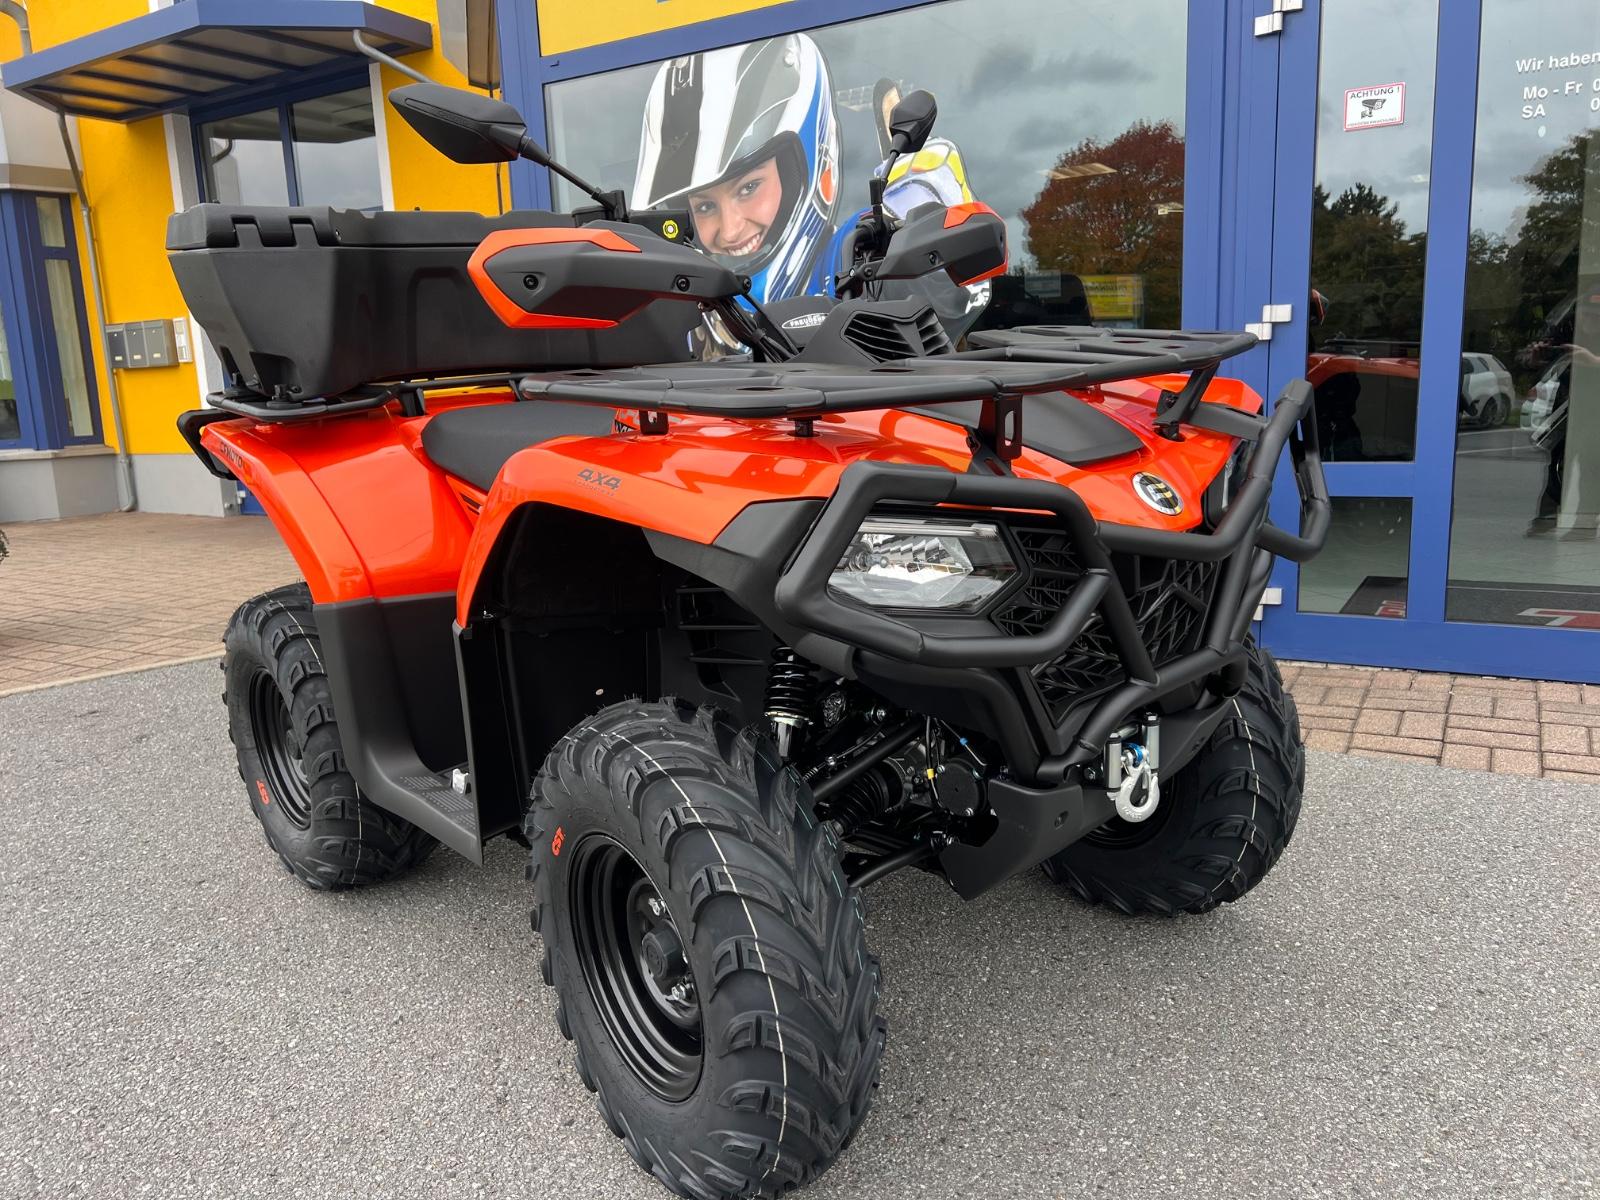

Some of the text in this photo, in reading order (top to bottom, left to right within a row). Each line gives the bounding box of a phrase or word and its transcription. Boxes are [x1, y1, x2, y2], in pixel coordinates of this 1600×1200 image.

[1516, 58, 1543, 73] Wir
[1350, 86, 1394, 99] ACHTUNG
[1523, 85, 1548, 100] Mo
[1565, 81, 1583, 95] Fr
[1522, 104, 1546, 119] SA
